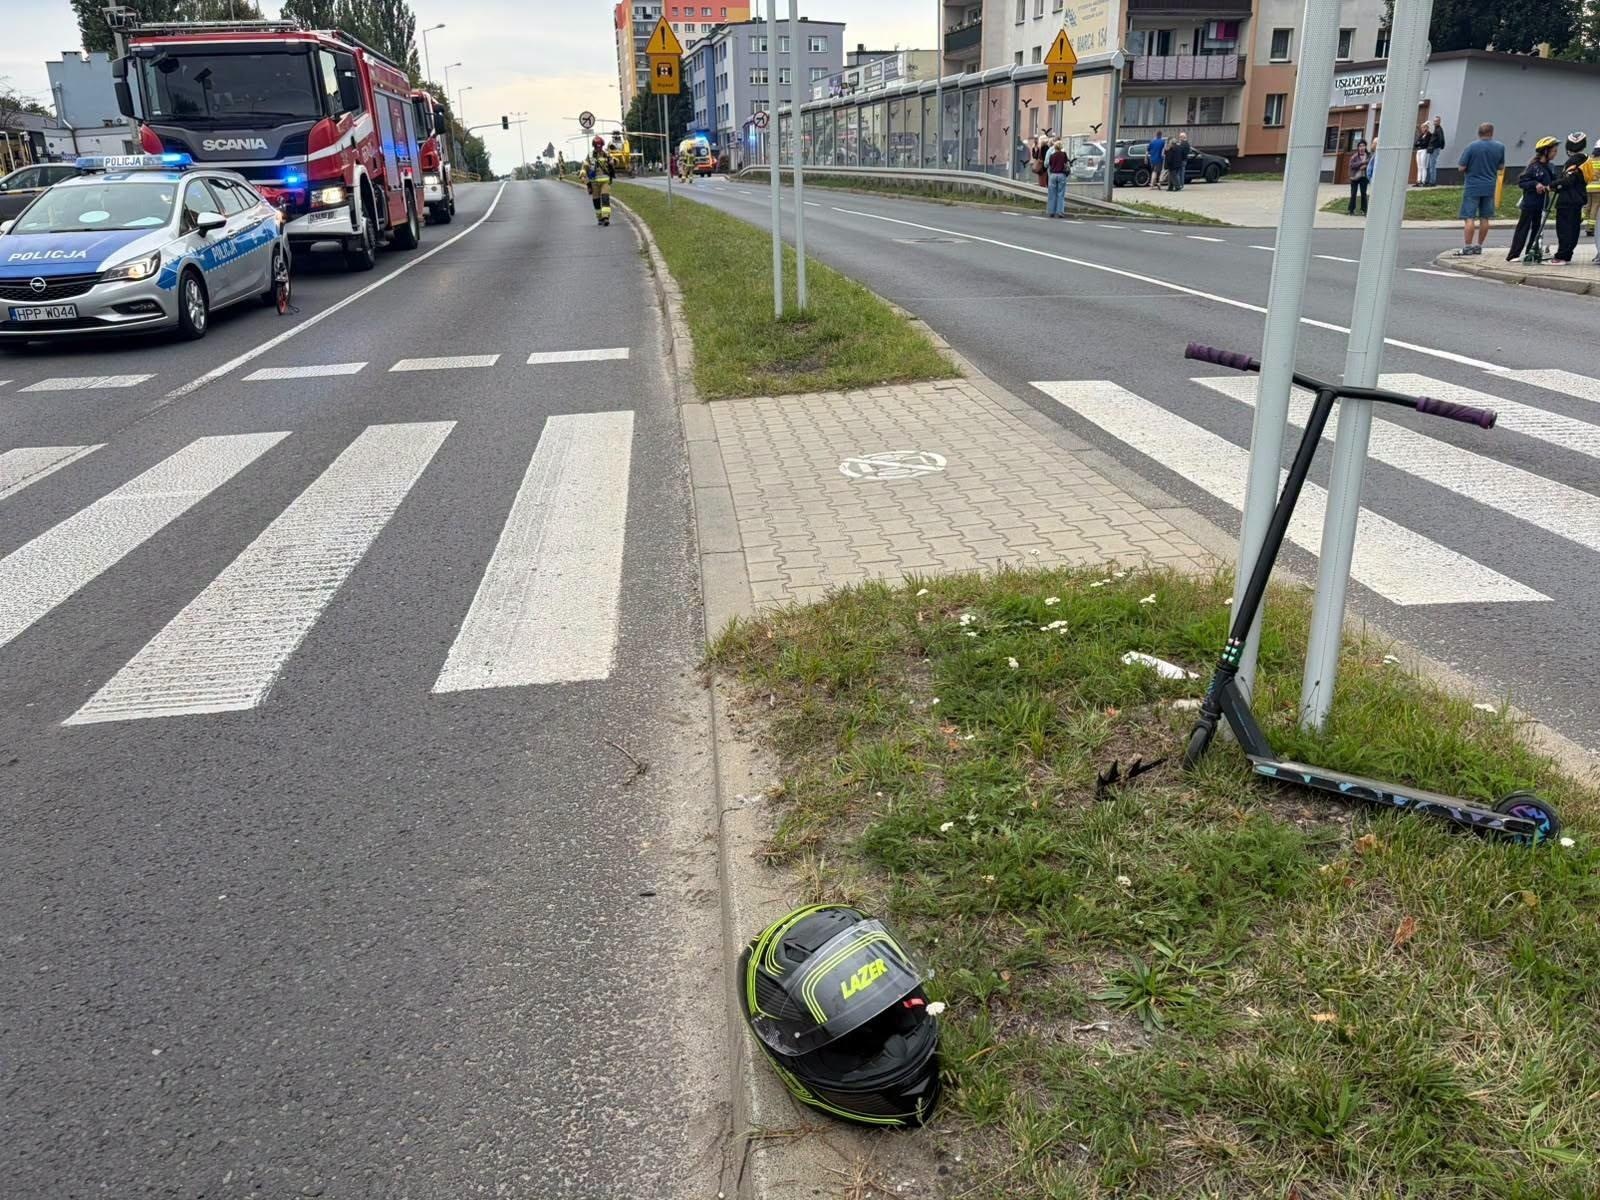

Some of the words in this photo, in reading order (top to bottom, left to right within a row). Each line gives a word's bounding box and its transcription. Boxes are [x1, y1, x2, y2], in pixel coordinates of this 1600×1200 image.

[1363, 74, 1387, 86] POGR
[202, 138, 268, 151] SCANIA
[105, 157, 143, 167] POLICJA
[8, 250, 87, 262] POLICJA
[211, 240, 238, 262] POLICJA
[17, 308, 41, 320] HPP
[841, 958, 888, 1000] LAZER
